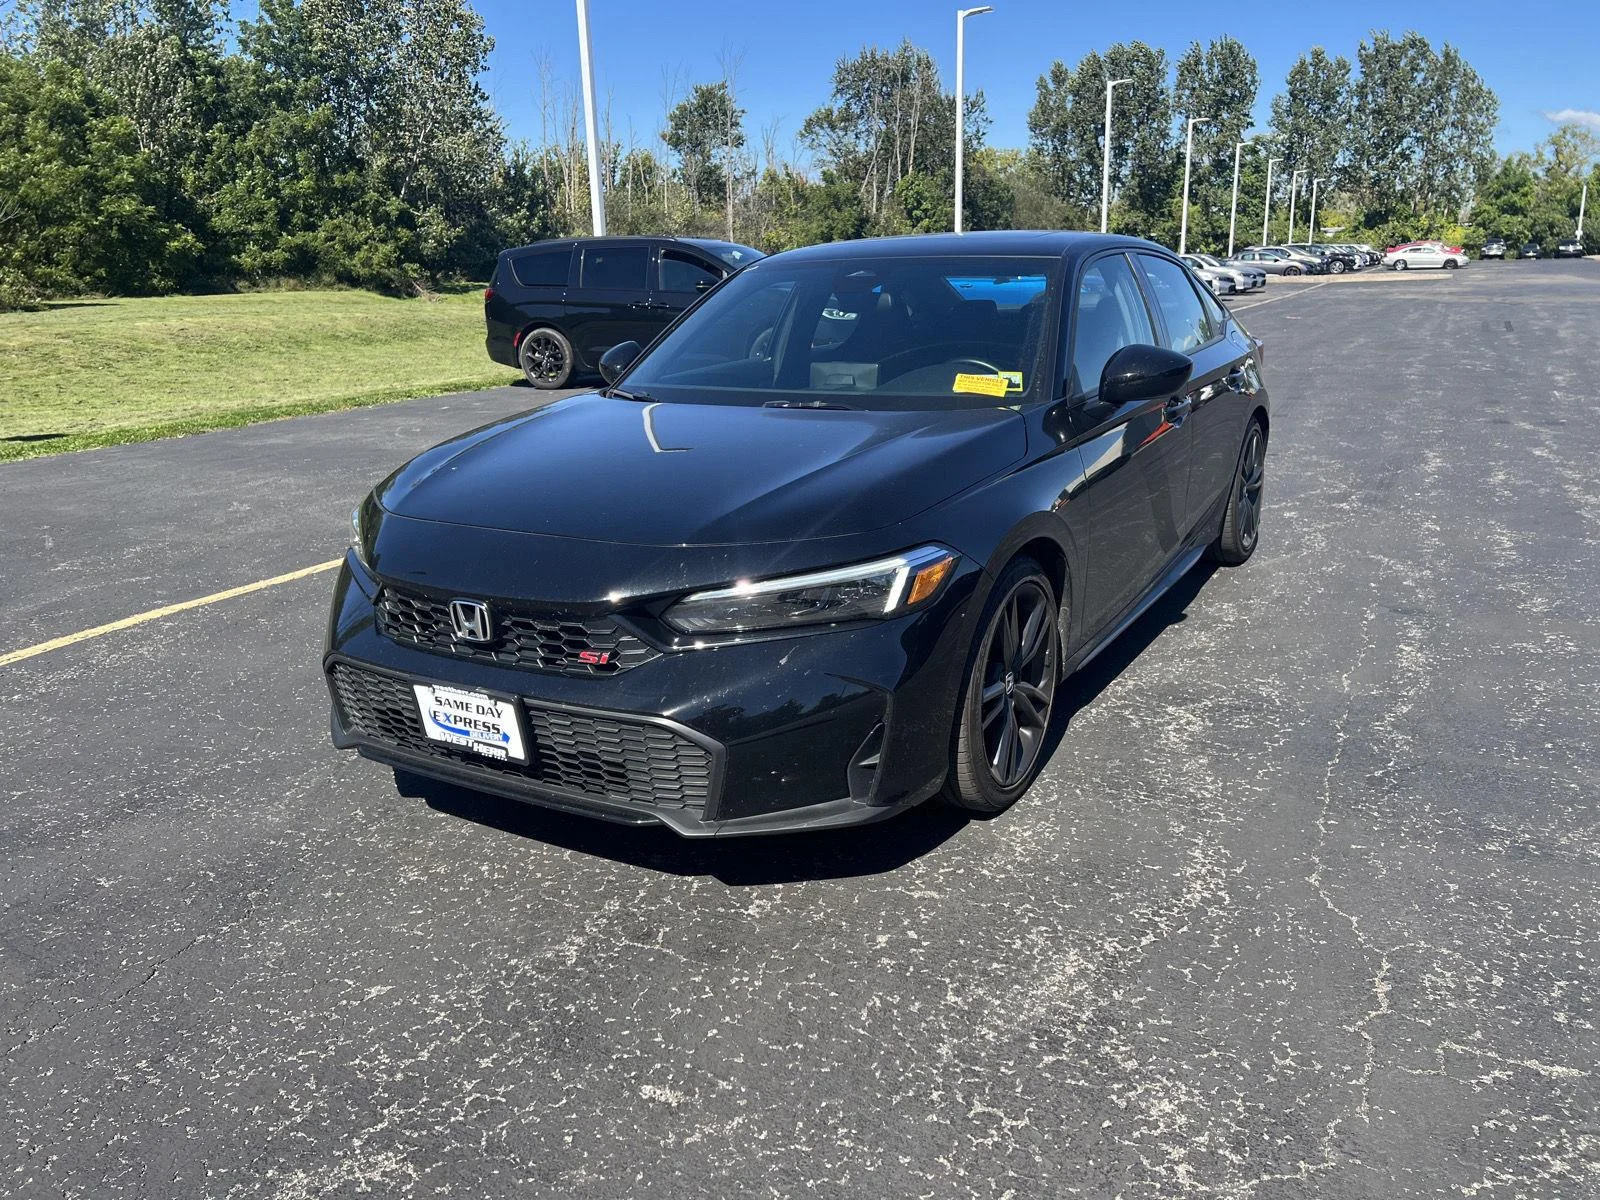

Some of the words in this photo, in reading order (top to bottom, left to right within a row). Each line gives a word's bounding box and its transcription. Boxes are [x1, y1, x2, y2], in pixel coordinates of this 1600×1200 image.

[434, 696, 473, 713] SAME
[476, 704, 503, 719] DAY
[432, 710, 501, 735] EXPRESS
